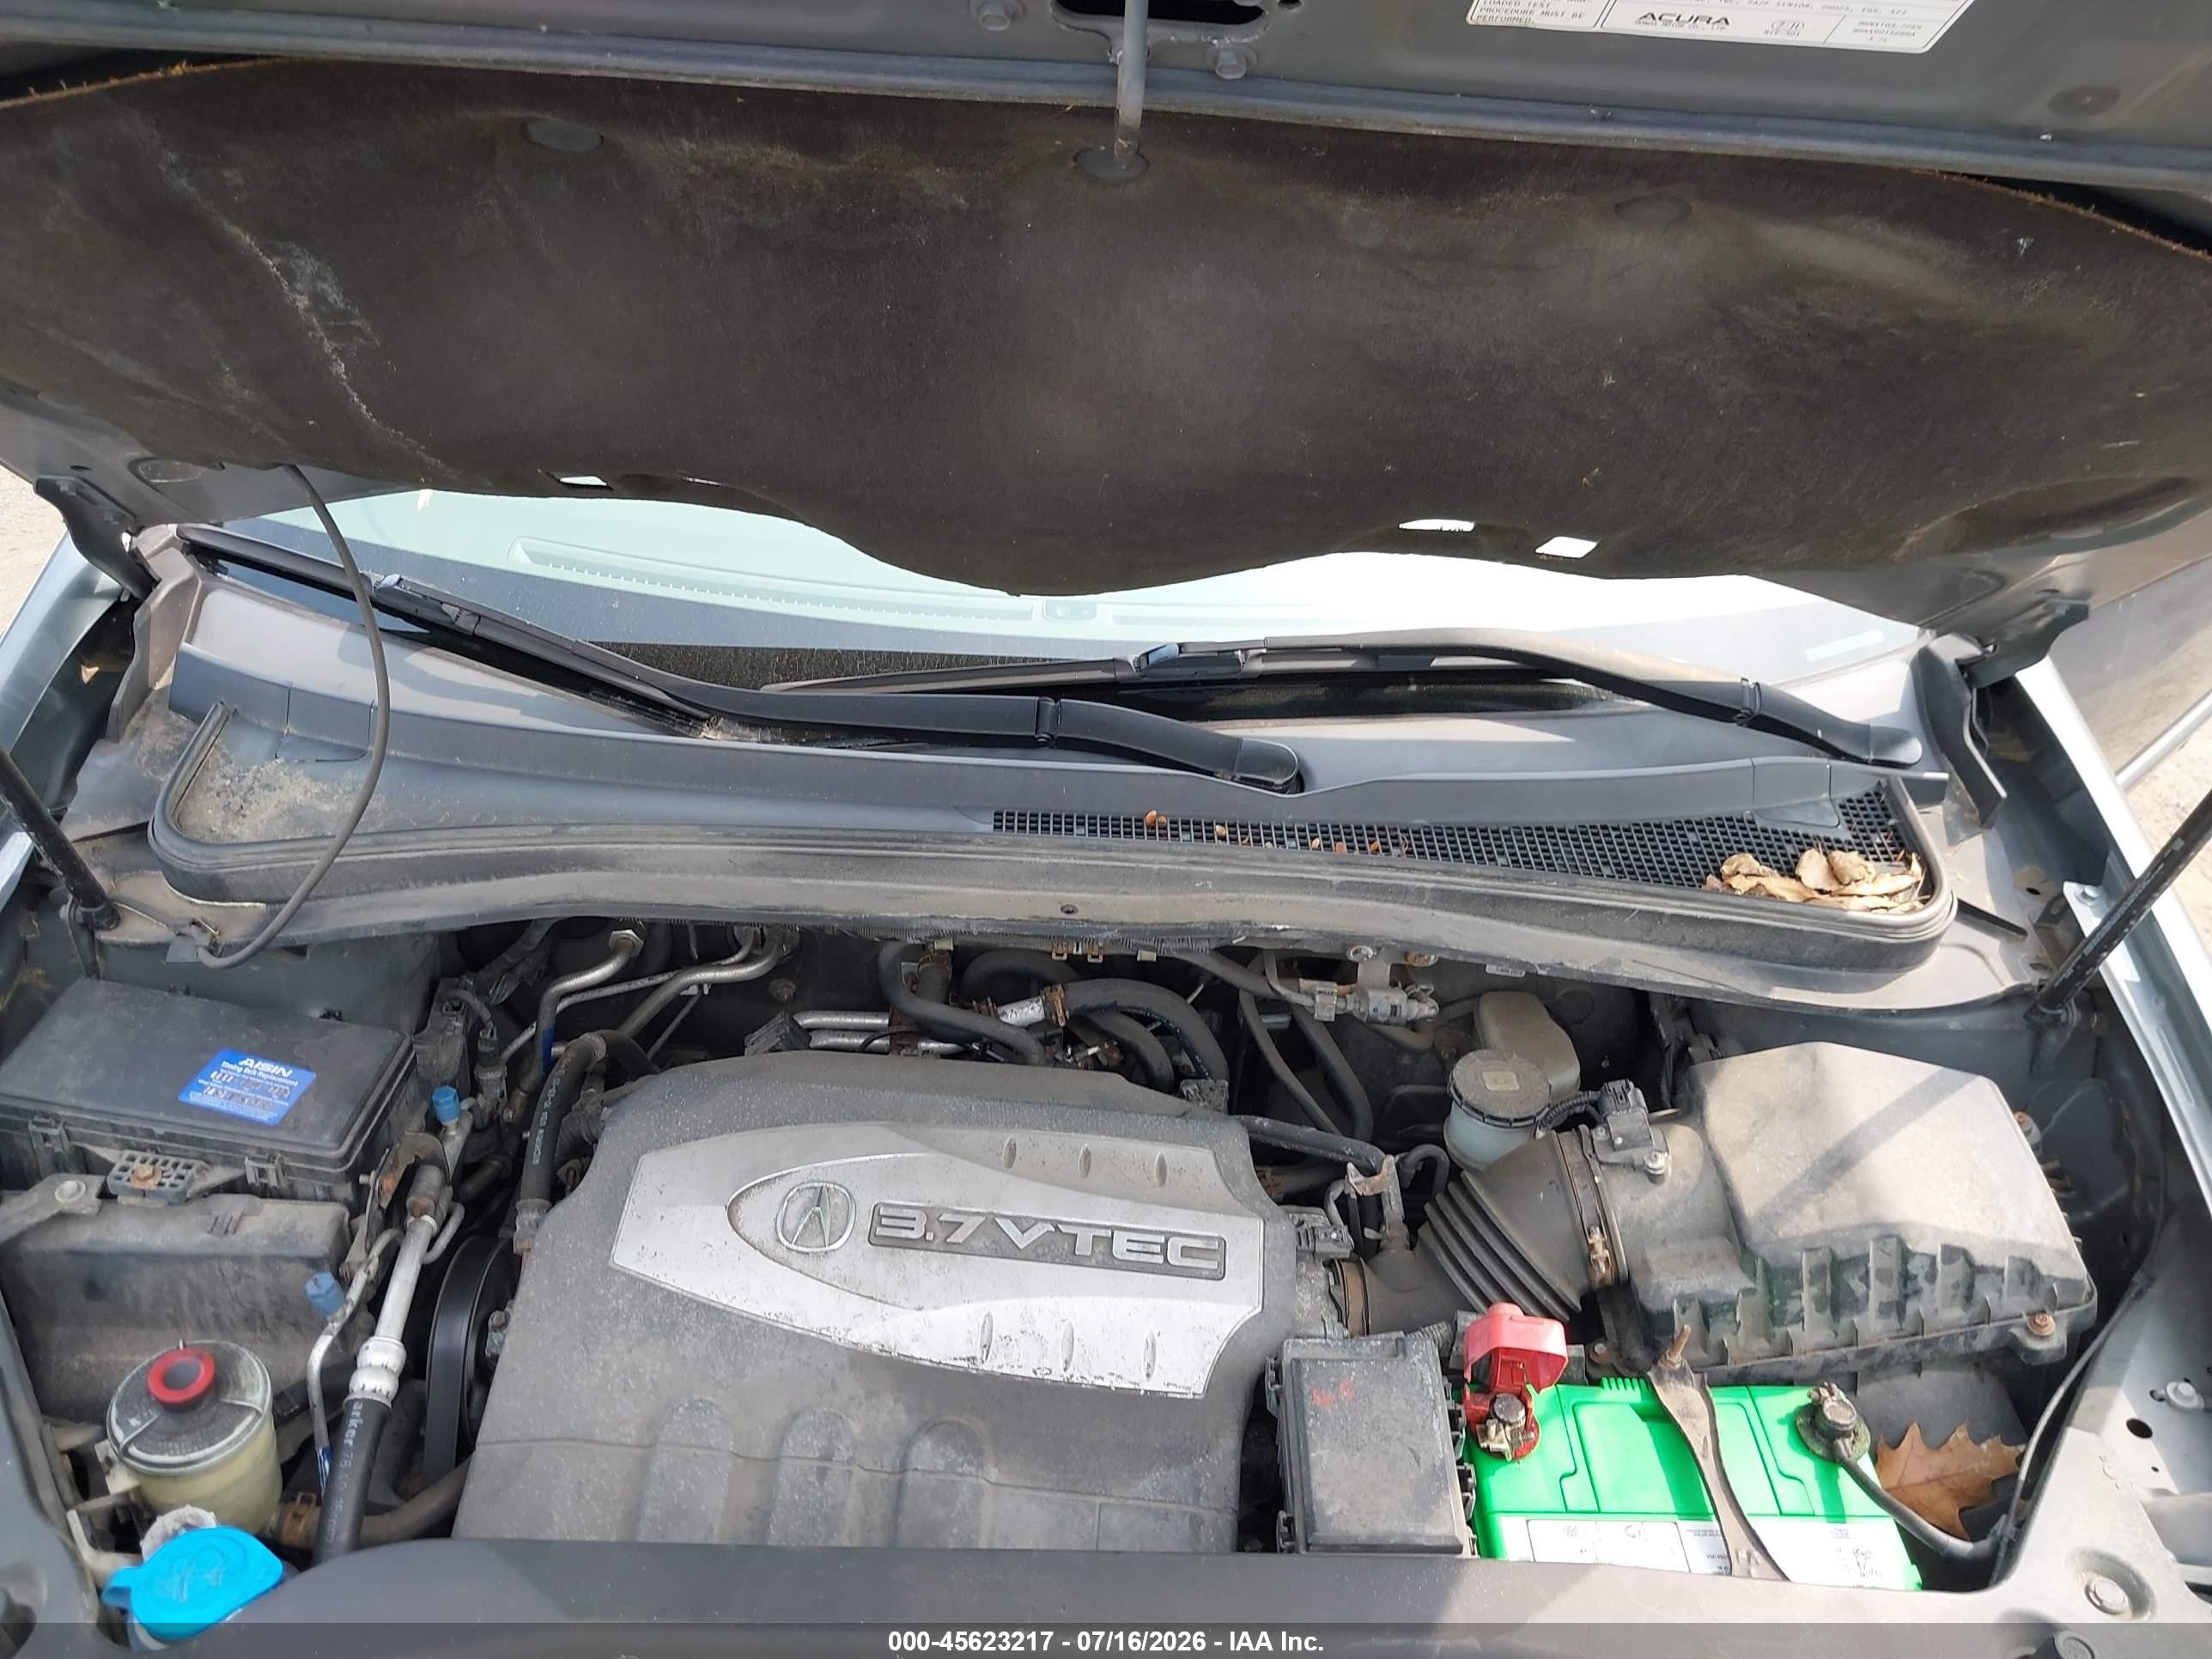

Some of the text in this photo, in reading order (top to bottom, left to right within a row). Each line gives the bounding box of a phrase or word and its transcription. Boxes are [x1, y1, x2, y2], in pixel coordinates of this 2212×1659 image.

[1480, 7, 1534, 15] PROCEDURE
[1638, 12, 1730, 26] ACURA
[239, 1058, 293, 1077] AISIN
[875, 1206, 1218, 1269] 3.7 VTEC
[344, 1401, 364, 1446] arker
